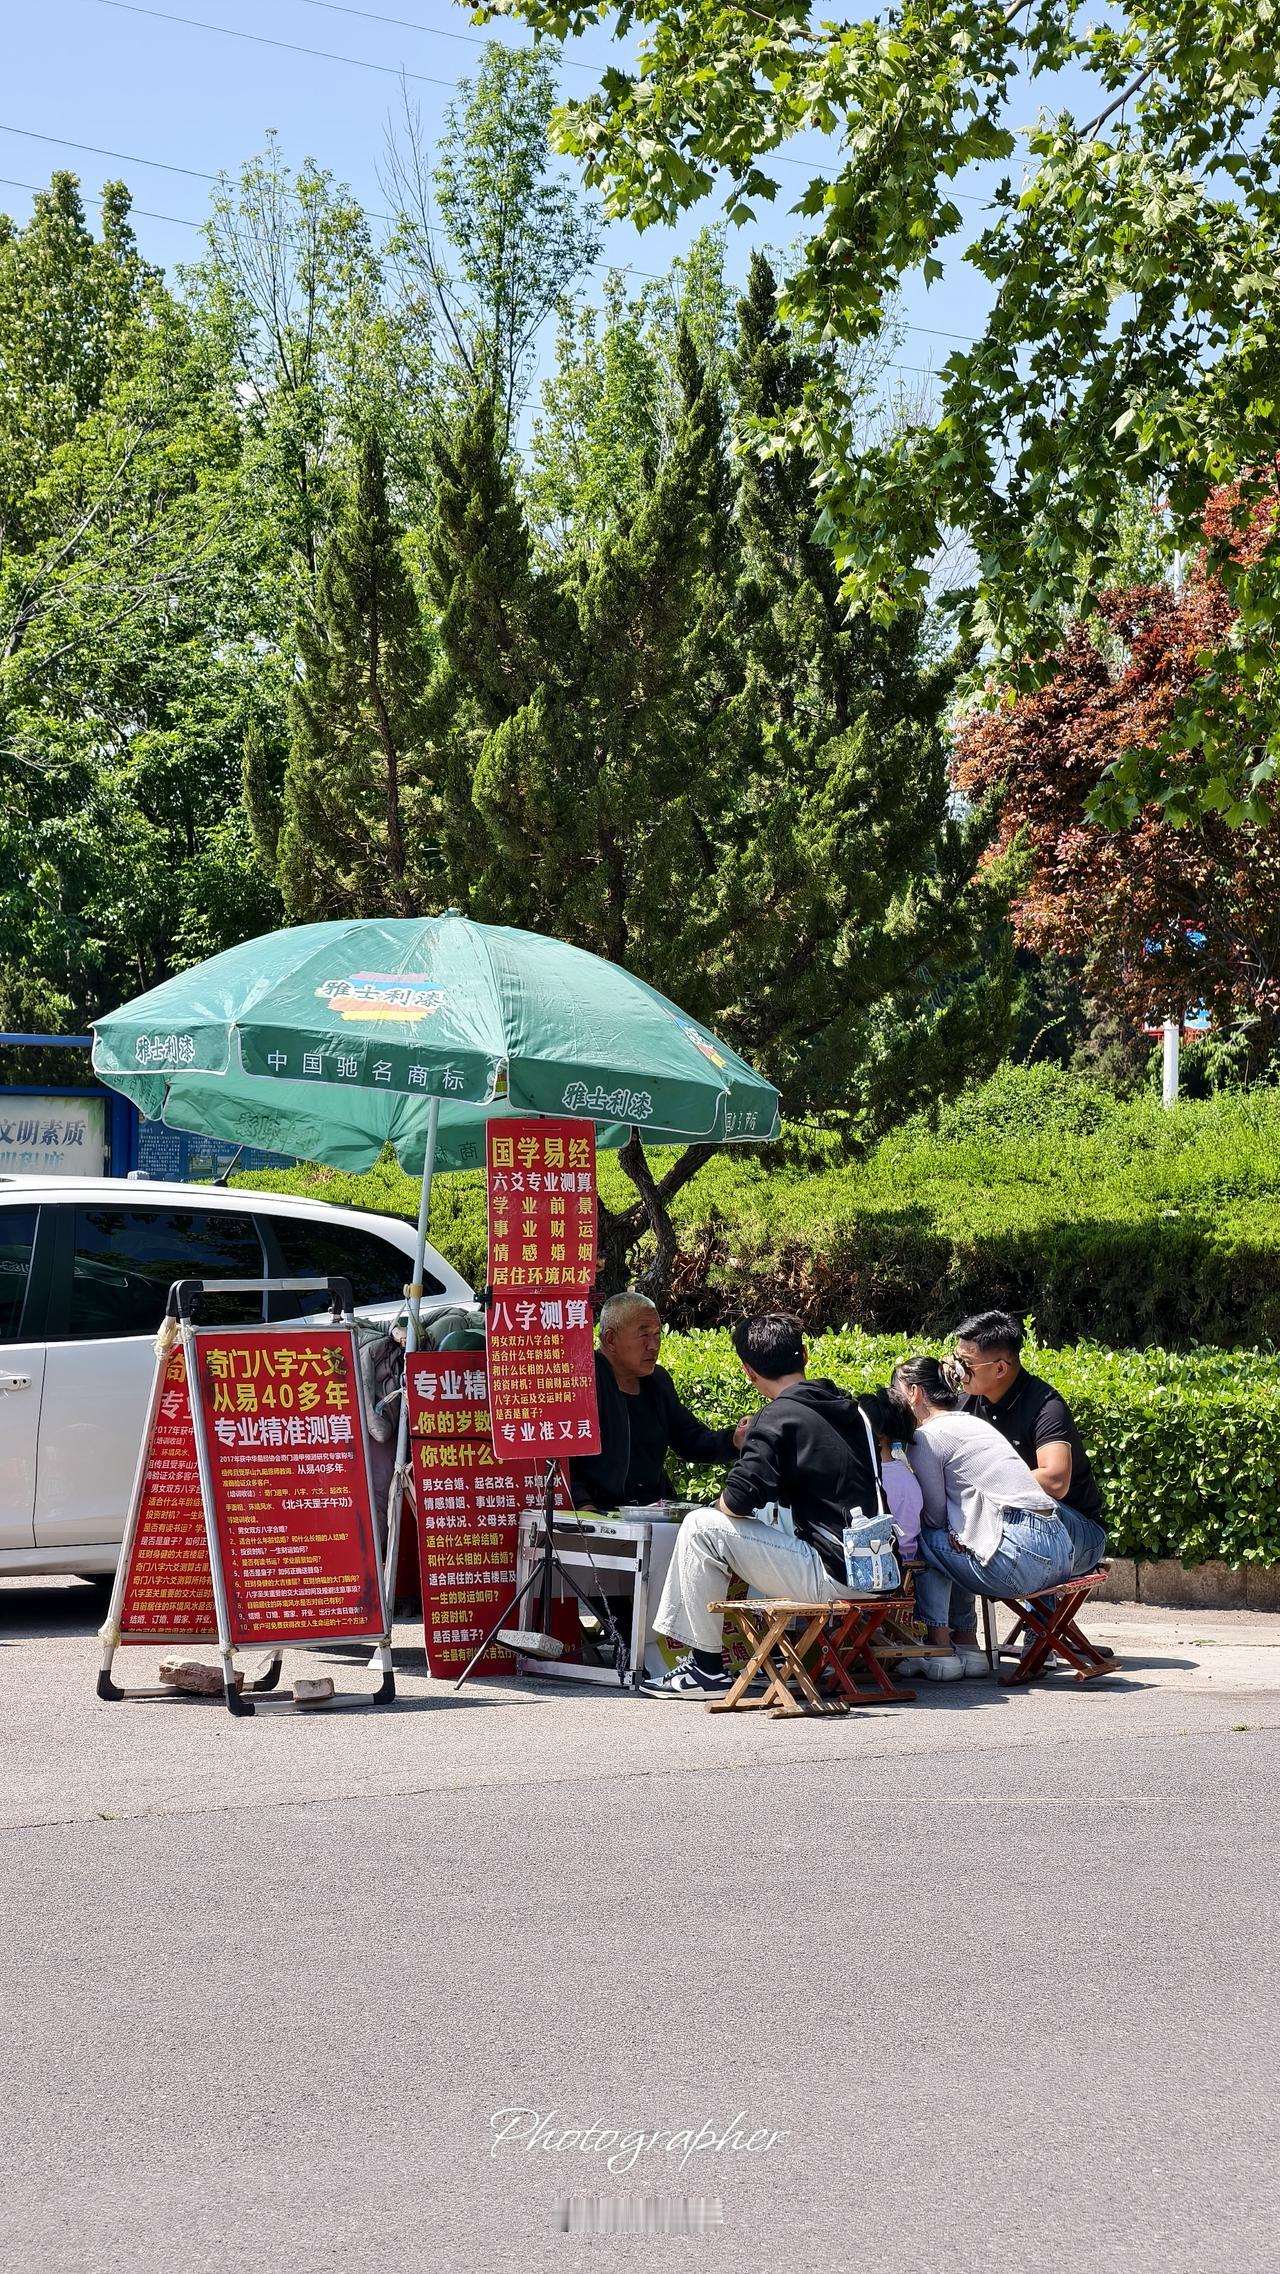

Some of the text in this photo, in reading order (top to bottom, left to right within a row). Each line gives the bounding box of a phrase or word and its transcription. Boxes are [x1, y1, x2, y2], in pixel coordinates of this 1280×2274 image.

[322, 979, 445, 1008] 雅士利漆
[136, 1034, 195, 1064] 雅士利漆
[267, 1050, 465, 1091] 中国驰名商标
[562, 1081, 653, 1120] 雅士利漆
[492, 1136, 591, 1169] 国学易经
[493, 1172, 593, 1192] 六爻专业测算
[493, 1196, 593, 1214] 学业前景
[493, 1220, 594, 1238] 事业财运
[494, 1243, 593, 1262] 情感婚姻
[493, 1267, 591, 1285] 居住环境风水
[491, 1299, 588, 1331] 八字测算
[491, 1334, 564, 1347] 男女双方八字合婚？
[206, 1347, 346, 1379] 奇门八字六爻
[492, 1348, 565, 1362] 适合什么年龄结婚？
[493, 1363, 574, 1377] 和什么长相的人结婚？
[414, 1369, 487, 1401] 专业精
[212, 1380, 350, 1413] 从易40多年
[495, 1408, 543, 1421] 是否是童子？
[214, 1414, 354, 1448] 专业精准测算
[501, 1420, 592, 1443] 专业准又灵
[420, 1443, 504, 1468] 你姓什么
[422, 1475, 562, 1492] 男女合婚、起名改名、环境水
[147, 1496, 203, 1507] 适合什么年龄结
[424, 1493, 564, 1511] 情感婚姻、事业财运、学业景
[426, 1533, 504, 1548] 适合什么年龄结婚？
[427, 1551, 514, 1567] 和什么长相的人结婚？
[129, 1588, 214, 1598] 八字至关重要的交大运时
[430, 1590, 499, 1605] 一生的财运如何？
[431, 1610, 474, 1624] 投资时机？
[432, 1629, 484, 1644] 是否是童子？
